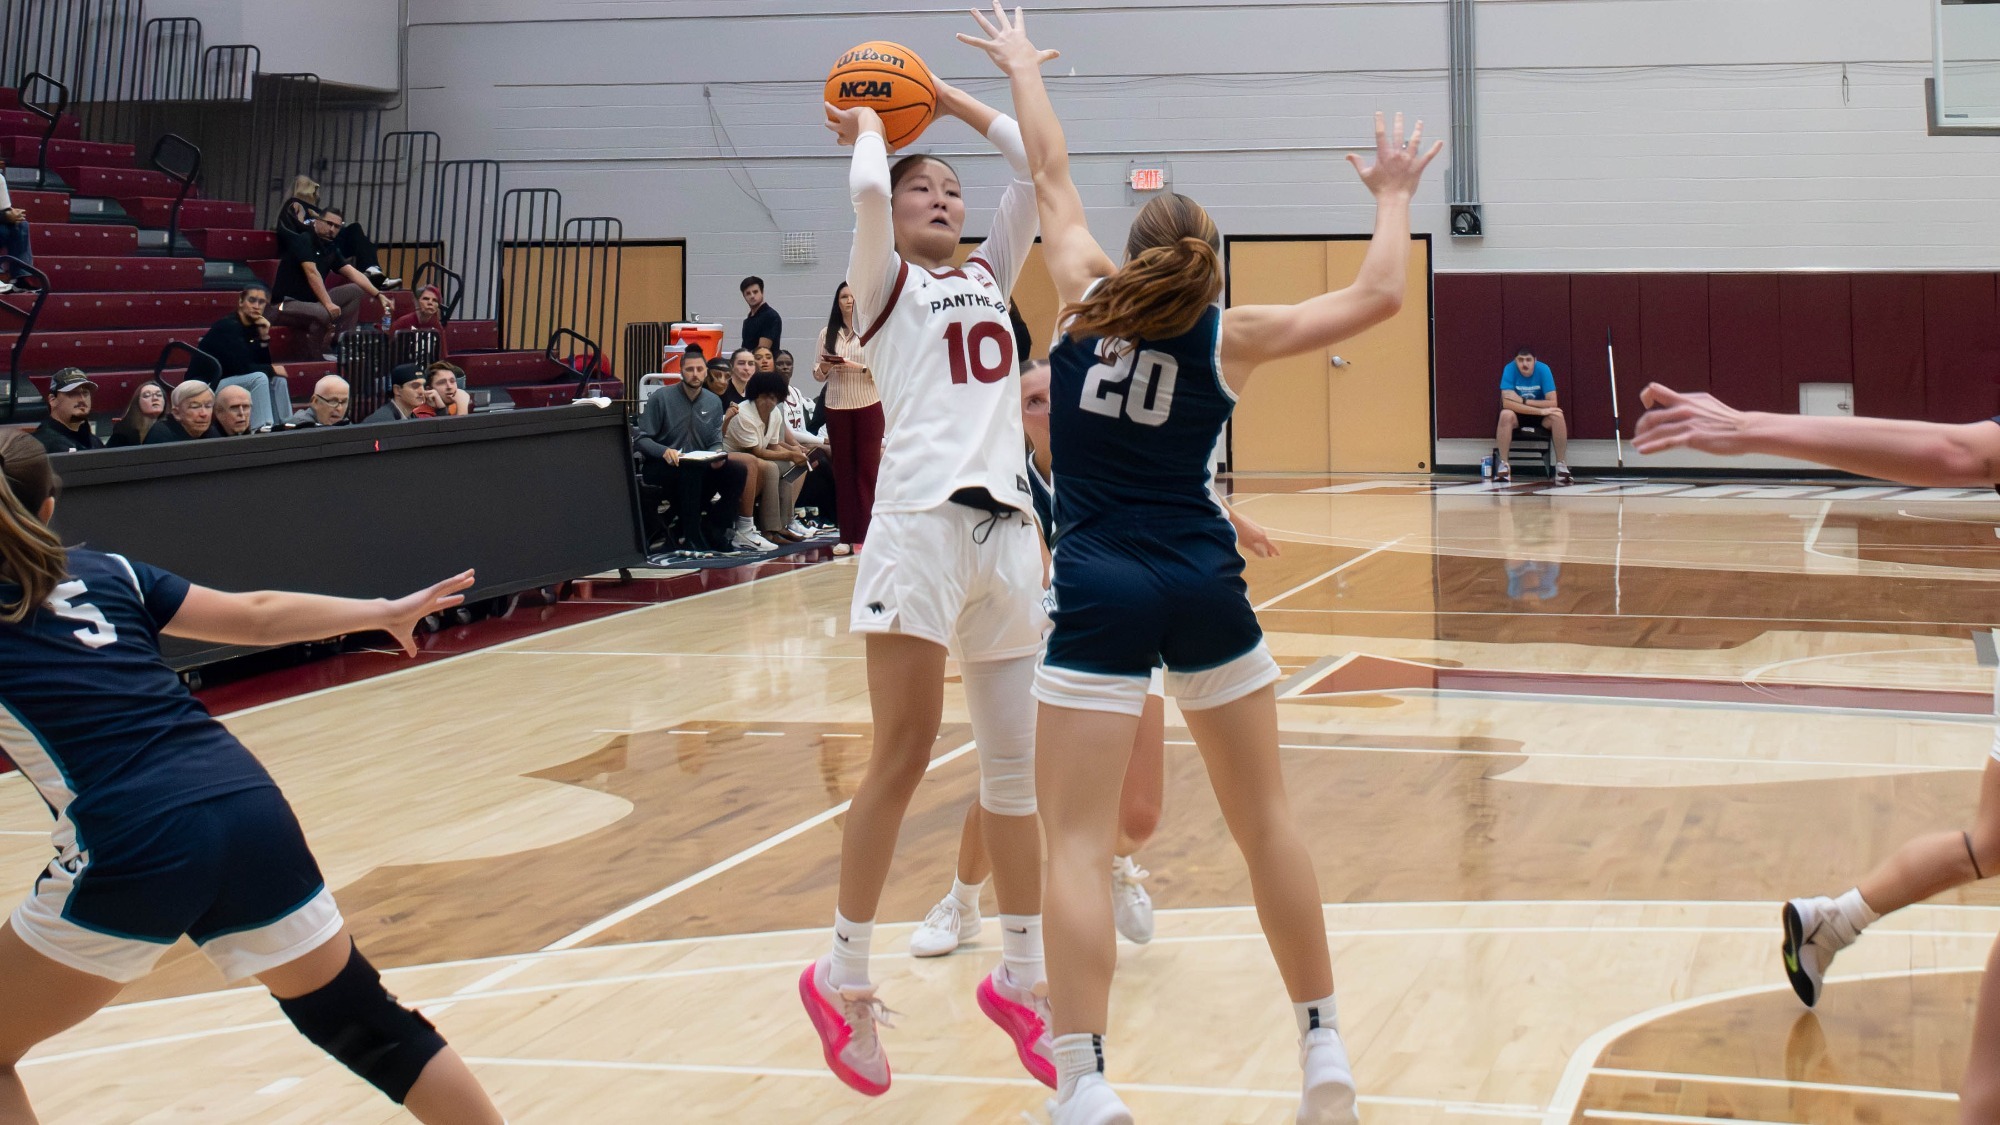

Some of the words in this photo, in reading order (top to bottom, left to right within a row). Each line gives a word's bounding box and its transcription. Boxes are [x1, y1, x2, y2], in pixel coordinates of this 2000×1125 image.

[837, 48, 905, 69] Wilson
[838, 80, 892, 98] NCAA
[1136, 169, 1159, 188] EXIT
[930, 293, 1006, 313] PANTHES
[942, 321, 1013, 385] 10
[1079, 337, 1179, 427] 20
[45, 579, 118, 649] 5
